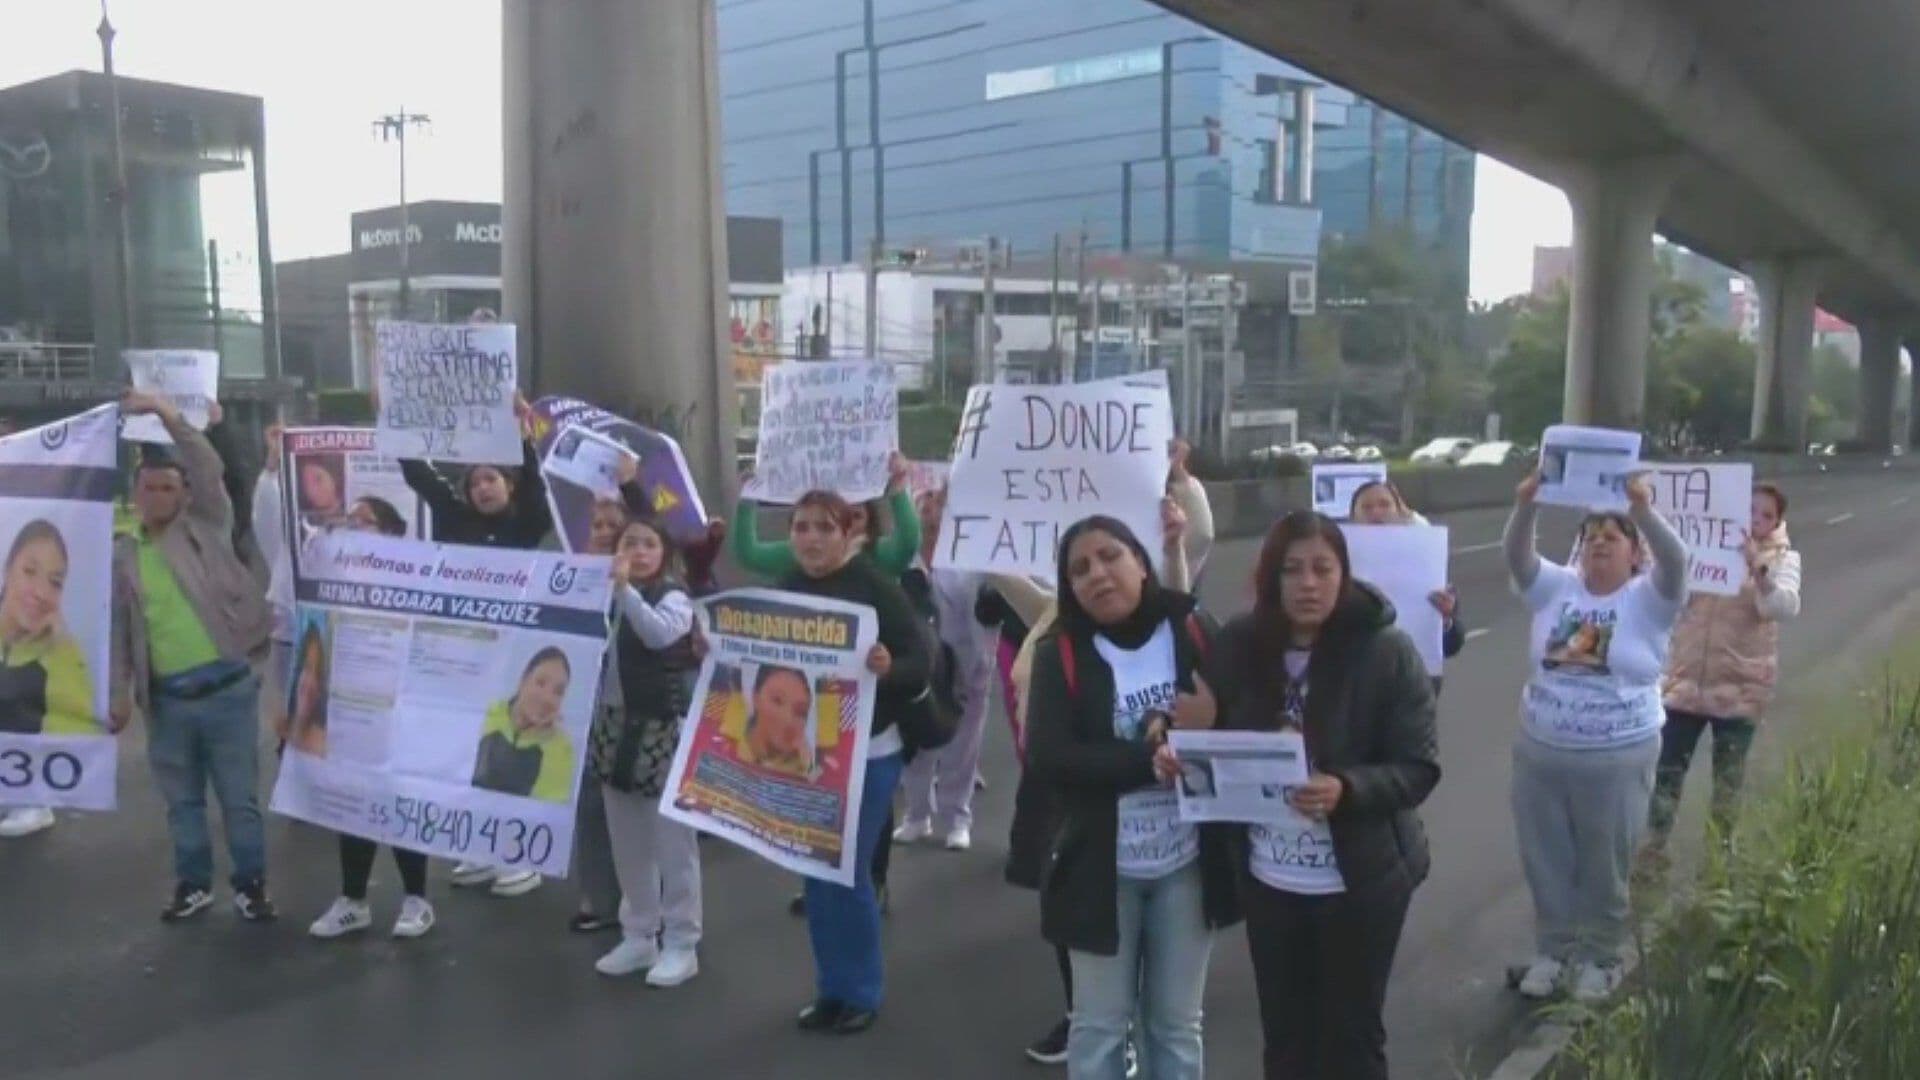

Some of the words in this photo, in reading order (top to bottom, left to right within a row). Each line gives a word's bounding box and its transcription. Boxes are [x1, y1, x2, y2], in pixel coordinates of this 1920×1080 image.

[455, 222, 501, 243] McD
[1015, 395, 1154, 455] DONDE
[295, 432, 373, 449] ¡DESAPARE
[1001, 467, 1100, 502] ESTA
[951, 515, 1060, 563] FATI
[450, 598, 541, 625] VAZQUEZ
[1125, 683, 1177, 711] BUSC
